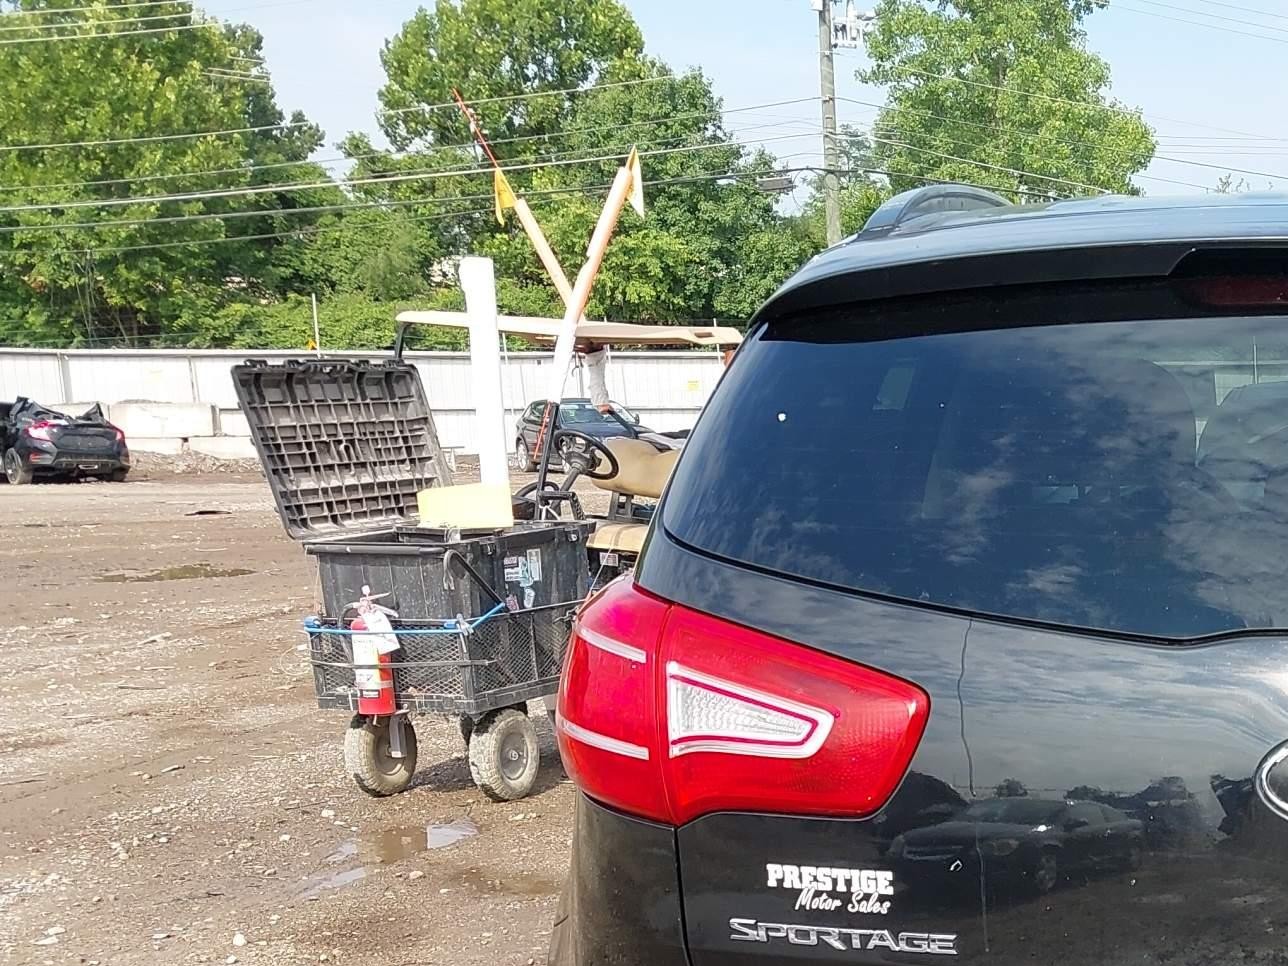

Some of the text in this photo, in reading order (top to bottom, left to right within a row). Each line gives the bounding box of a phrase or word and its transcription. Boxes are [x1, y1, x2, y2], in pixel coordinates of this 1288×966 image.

[766, 863, 895, 895] PRESTIGE
[794, 887, 892, 915] Motor Sales
[729, 918, 959, 955] SPORTAGE
